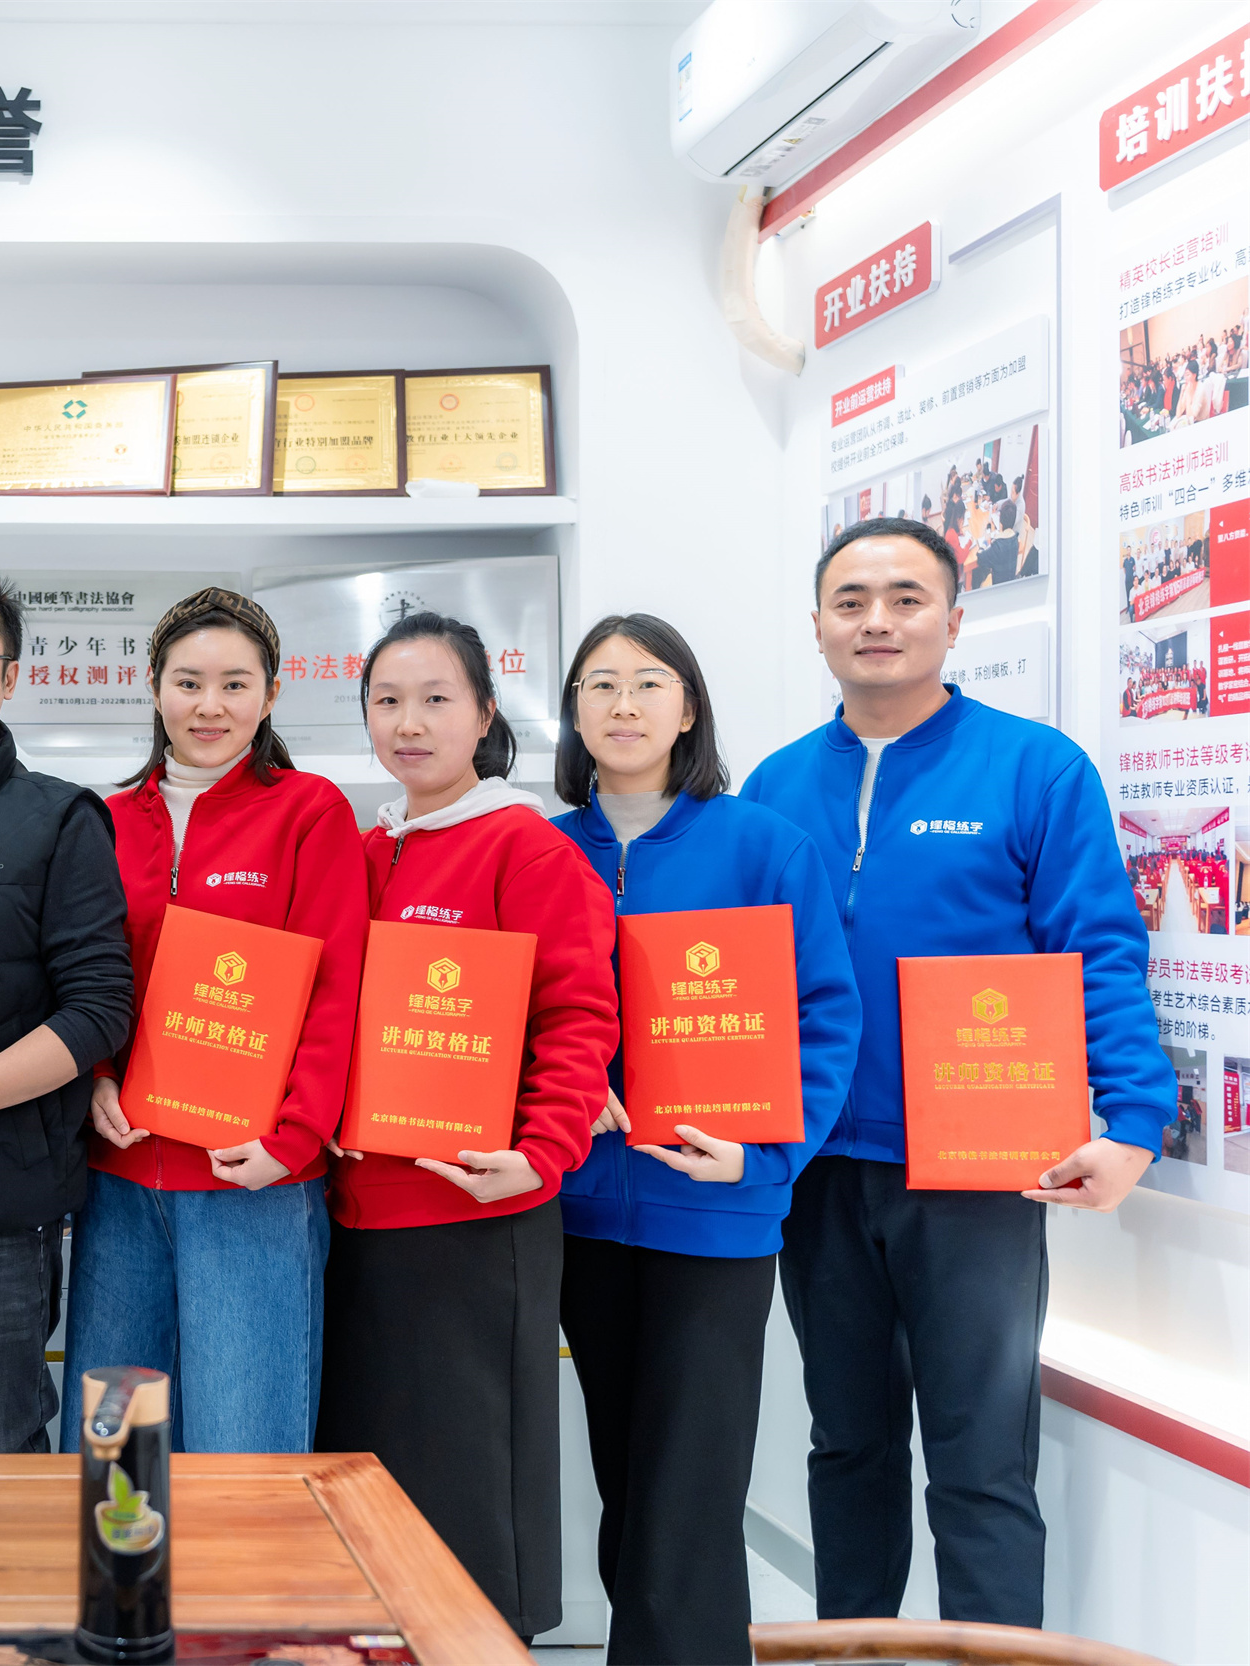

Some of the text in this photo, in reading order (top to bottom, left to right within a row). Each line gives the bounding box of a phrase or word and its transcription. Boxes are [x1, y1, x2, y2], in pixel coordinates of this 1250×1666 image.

[1116, 38, 1250, 163] 培训扶
[1119, 221, 1229, 292] 精英校长运营培训
[823, 243, 917, 332] 开业扶持
[1119, 245, 1250, 320] 打造锋格练字专业化、高
[835, 376, 892, 418] 开业前运营扶持
[1119, 440, 1229, 494] 高级书法讲师培训
[1119, 467, 1250, 522] 特色师训“四合一”多维
[193, 982, 255, 1008] 锋格练字
[671, 978, 738, 996] 锋格练字
[408, 993, 473, 1013] 锋格练字
[1150, 989, 1250, 1015] 考生艺术综合素质
[164, 1010, 269, 1052] 讲师资格证
[650, 1012, 766, 1036] 讲师资格证
[956, 1026, 1027, 1043] 锋格练字
[188, 1036, 229, 1051] QUALIFICATION
[230, 1046, 264, 1060] CERTIFICATE
[382, 1026, 492, 1055] 讲师资格证
[408, 1050, 452, 1059] QUALIFICATION
[452, 1054, 489, 1063] CERTIFICATE
[934, 1061, 1056, 1082] 讲师资格证
[146, 1094, 250, 1128] 北京锋格书法培训有限公司
[654, 1102, 771, 1115] 北京锋格书法培训有限公司
[370, 1112, 482, 1135] 北京锋格书法培训有限公司
[938, 1150, 1061, 1161] 北京锋格书法培训有限公司
